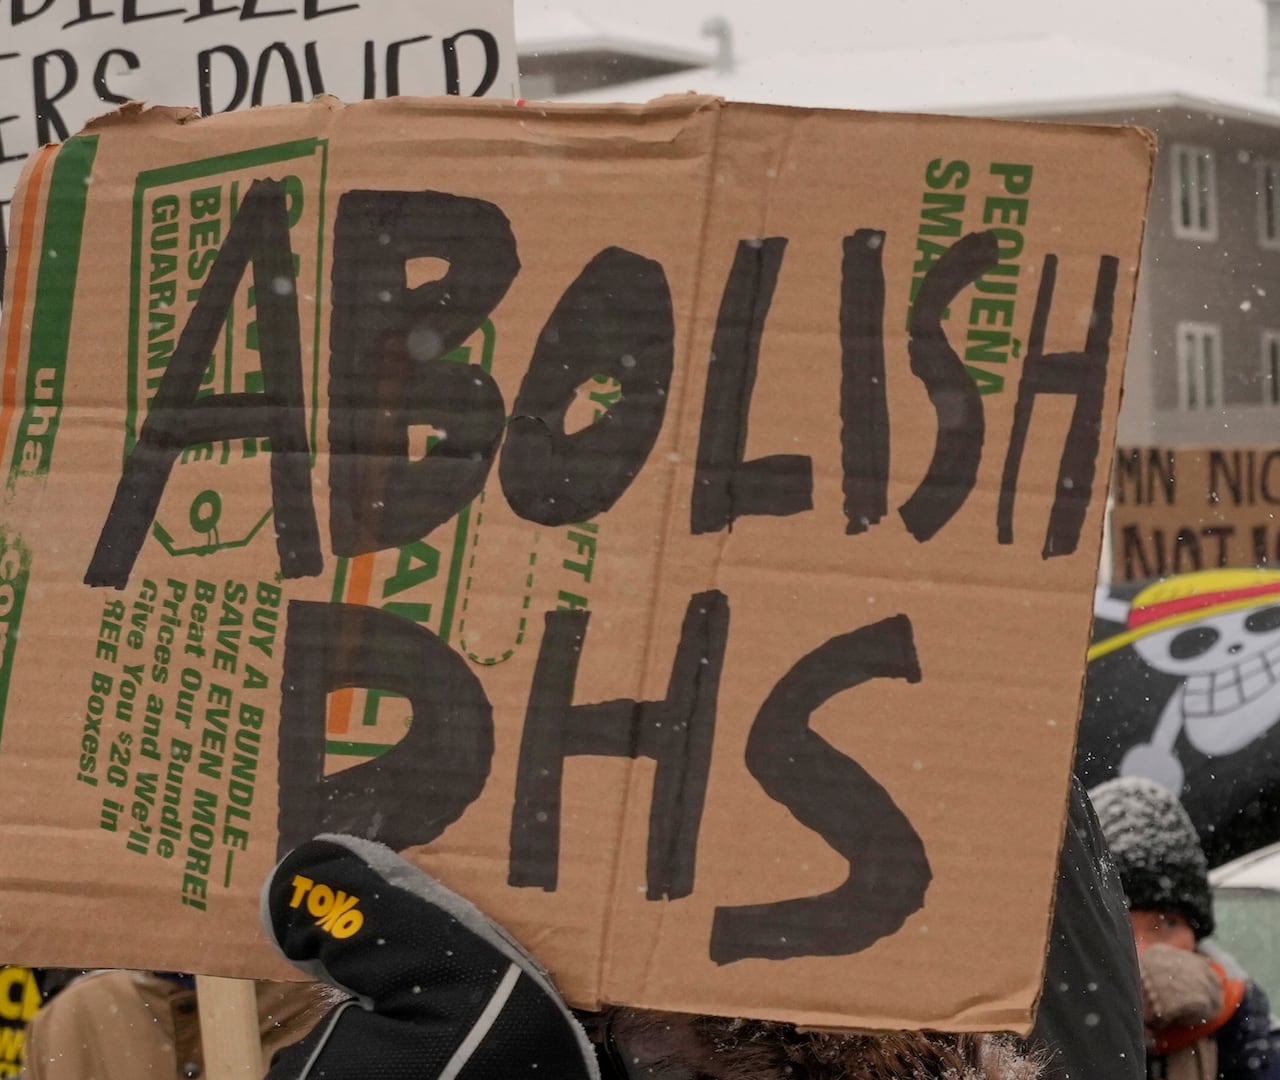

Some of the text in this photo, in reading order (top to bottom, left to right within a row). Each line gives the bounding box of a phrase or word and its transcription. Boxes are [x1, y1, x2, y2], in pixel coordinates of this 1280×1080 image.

[83, 177, 1119, 590] ABOLISH
[1115, 448, 1175, 506] MN
[1122, 521, 1235, 582] NOT
[77, 599, 126, 786] REE Boxes!
[115, 664, 146, 722] You
[126, 578, 188, 855] Prices and We'll
[157, 579, 216, 859] Beat Our Bundle
[244, 664, 270, 690] A
[106, 731, 133, 789] $20
[182, 579, 247, 911] SAVE EVEN MORE!
[276, 588, 933, 967] DHS
[100, 798, 123, 832] in
